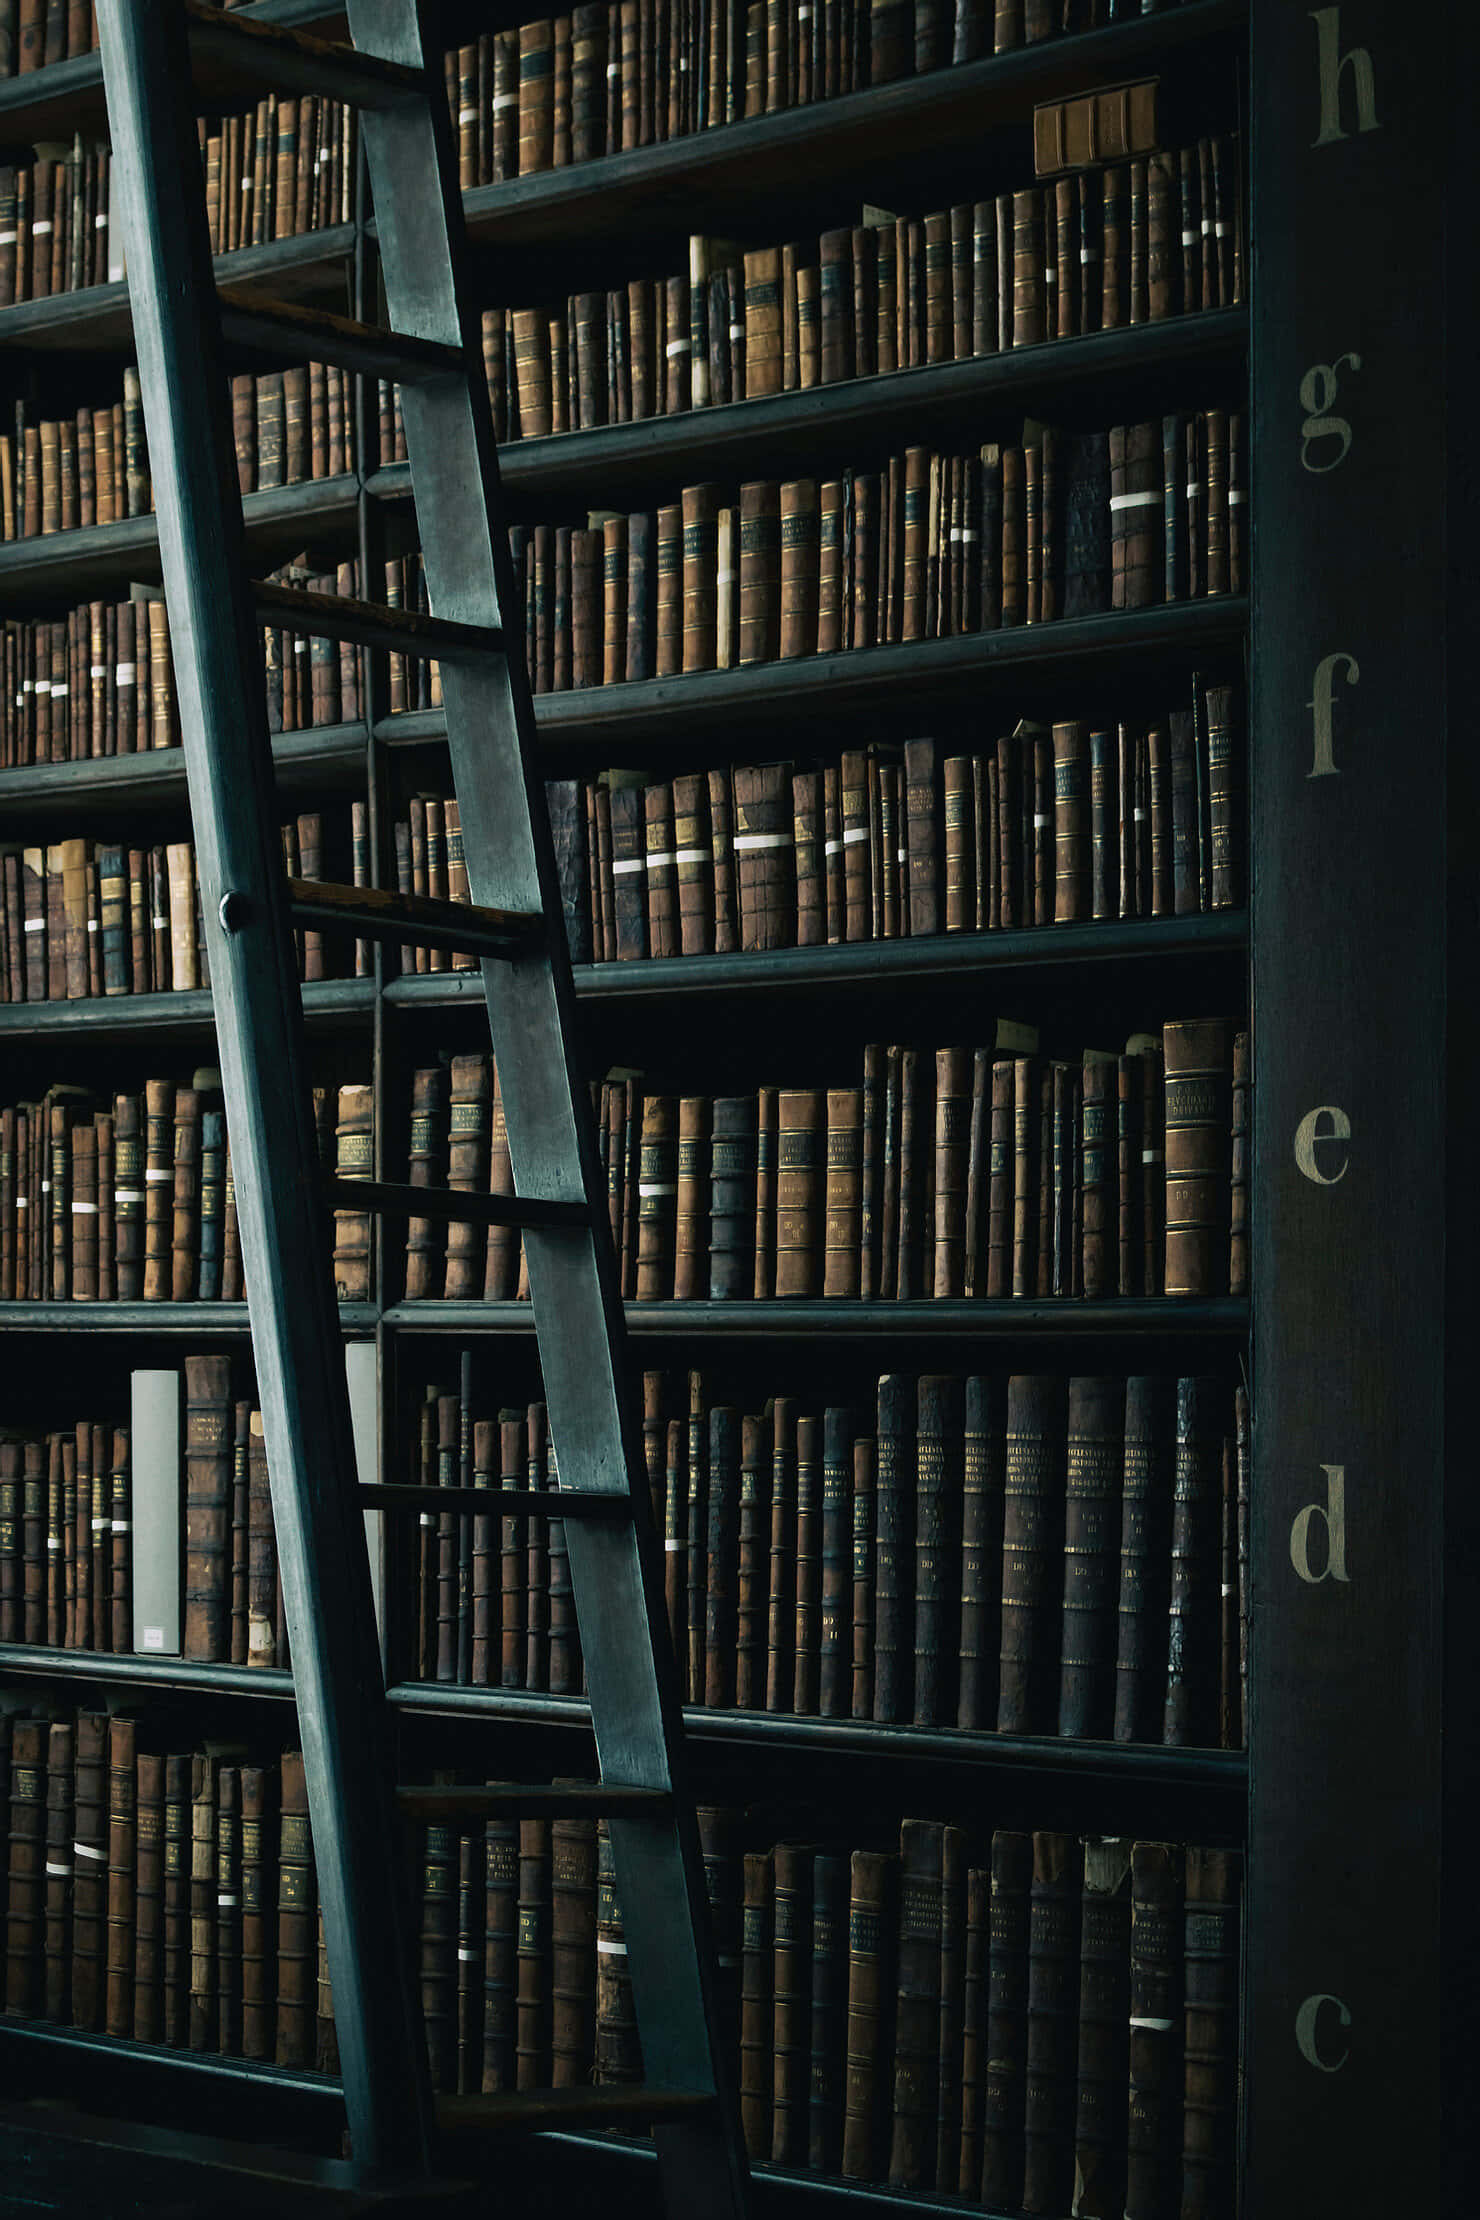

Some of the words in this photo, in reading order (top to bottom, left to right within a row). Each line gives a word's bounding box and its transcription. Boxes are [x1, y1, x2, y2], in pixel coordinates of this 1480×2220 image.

[1308, 6, 1380, 149] h
[1300, 352, 1362, 475] g
[1305, 652, 1360, 779] f
[1294, 1105, 1351, 1185] e
[1289, 1463, 1350, 1583] d
[1294, 1993, 1352, 2073] c
